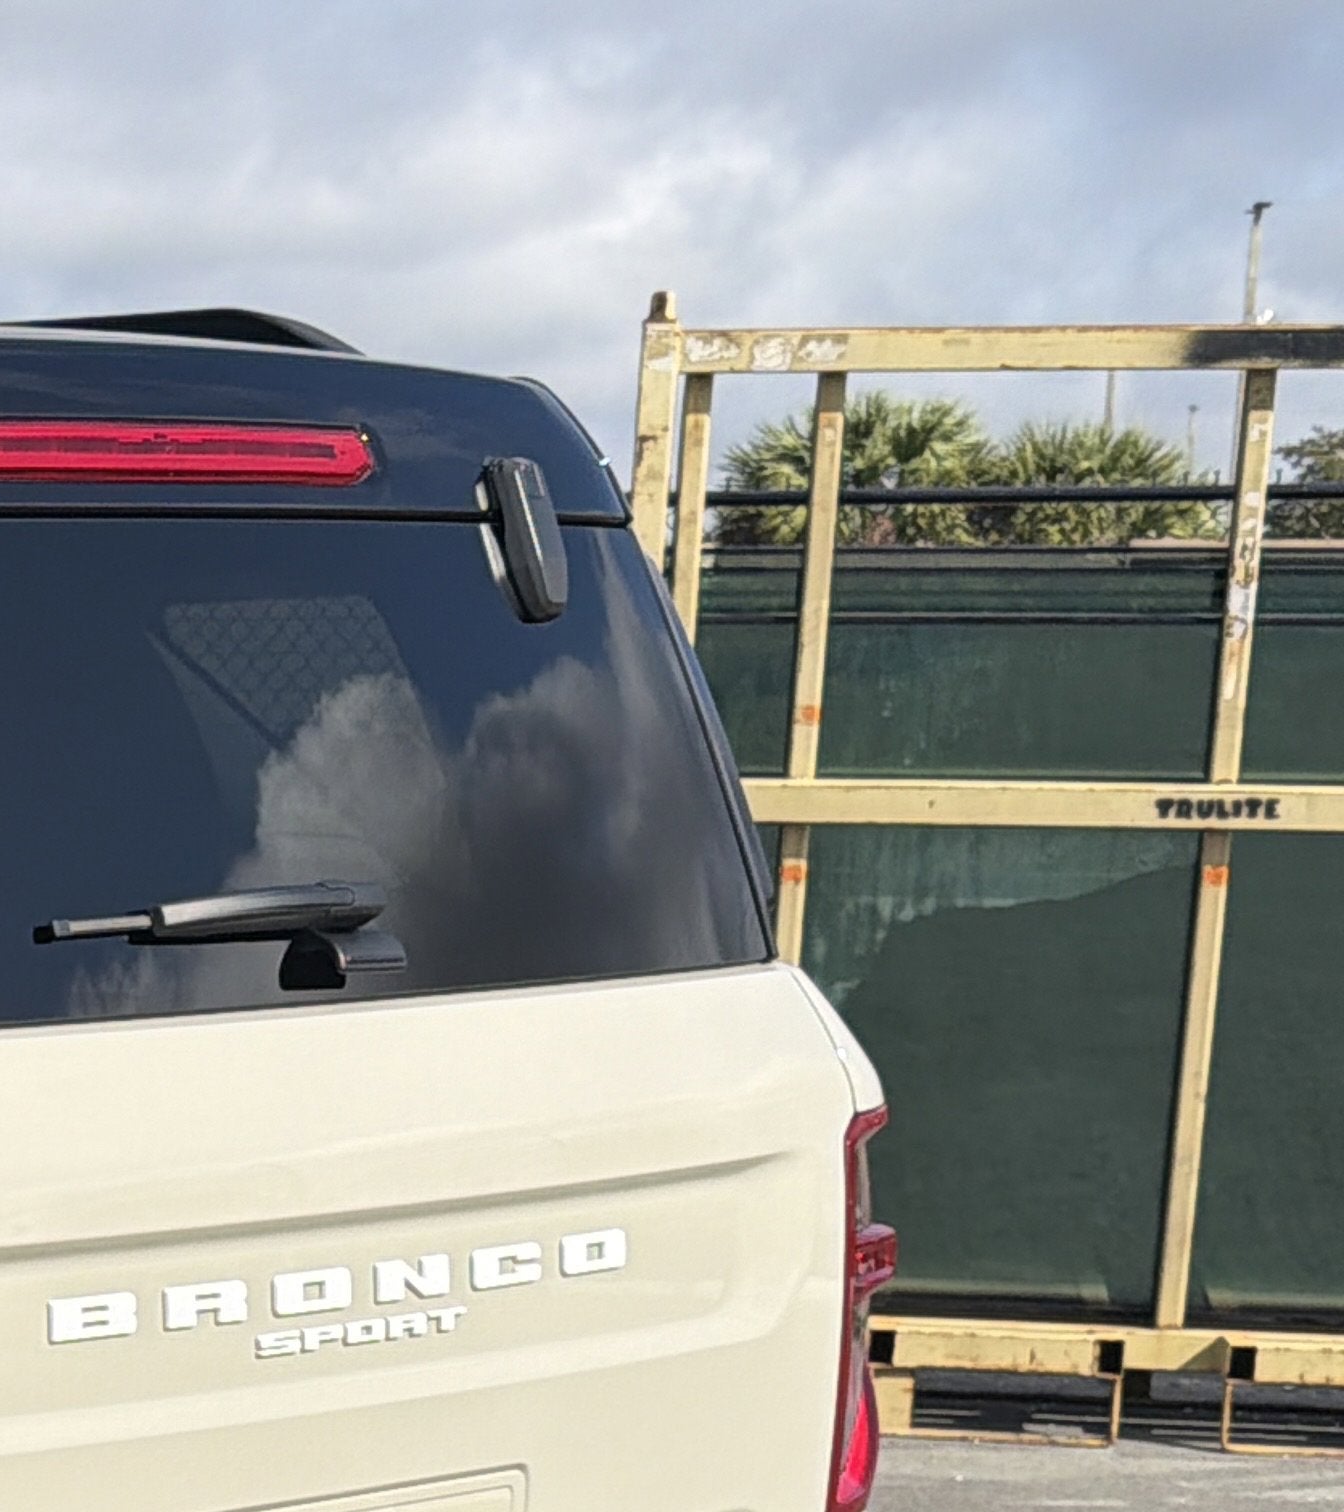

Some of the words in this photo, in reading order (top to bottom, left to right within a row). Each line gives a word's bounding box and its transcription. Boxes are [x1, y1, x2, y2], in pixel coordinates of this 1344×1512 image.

[1155, 798, 1281, 820] TRULITE
[46, 1227, 628, 1345] BRONCO
[254, 1305, 468, 1359] SPORT
